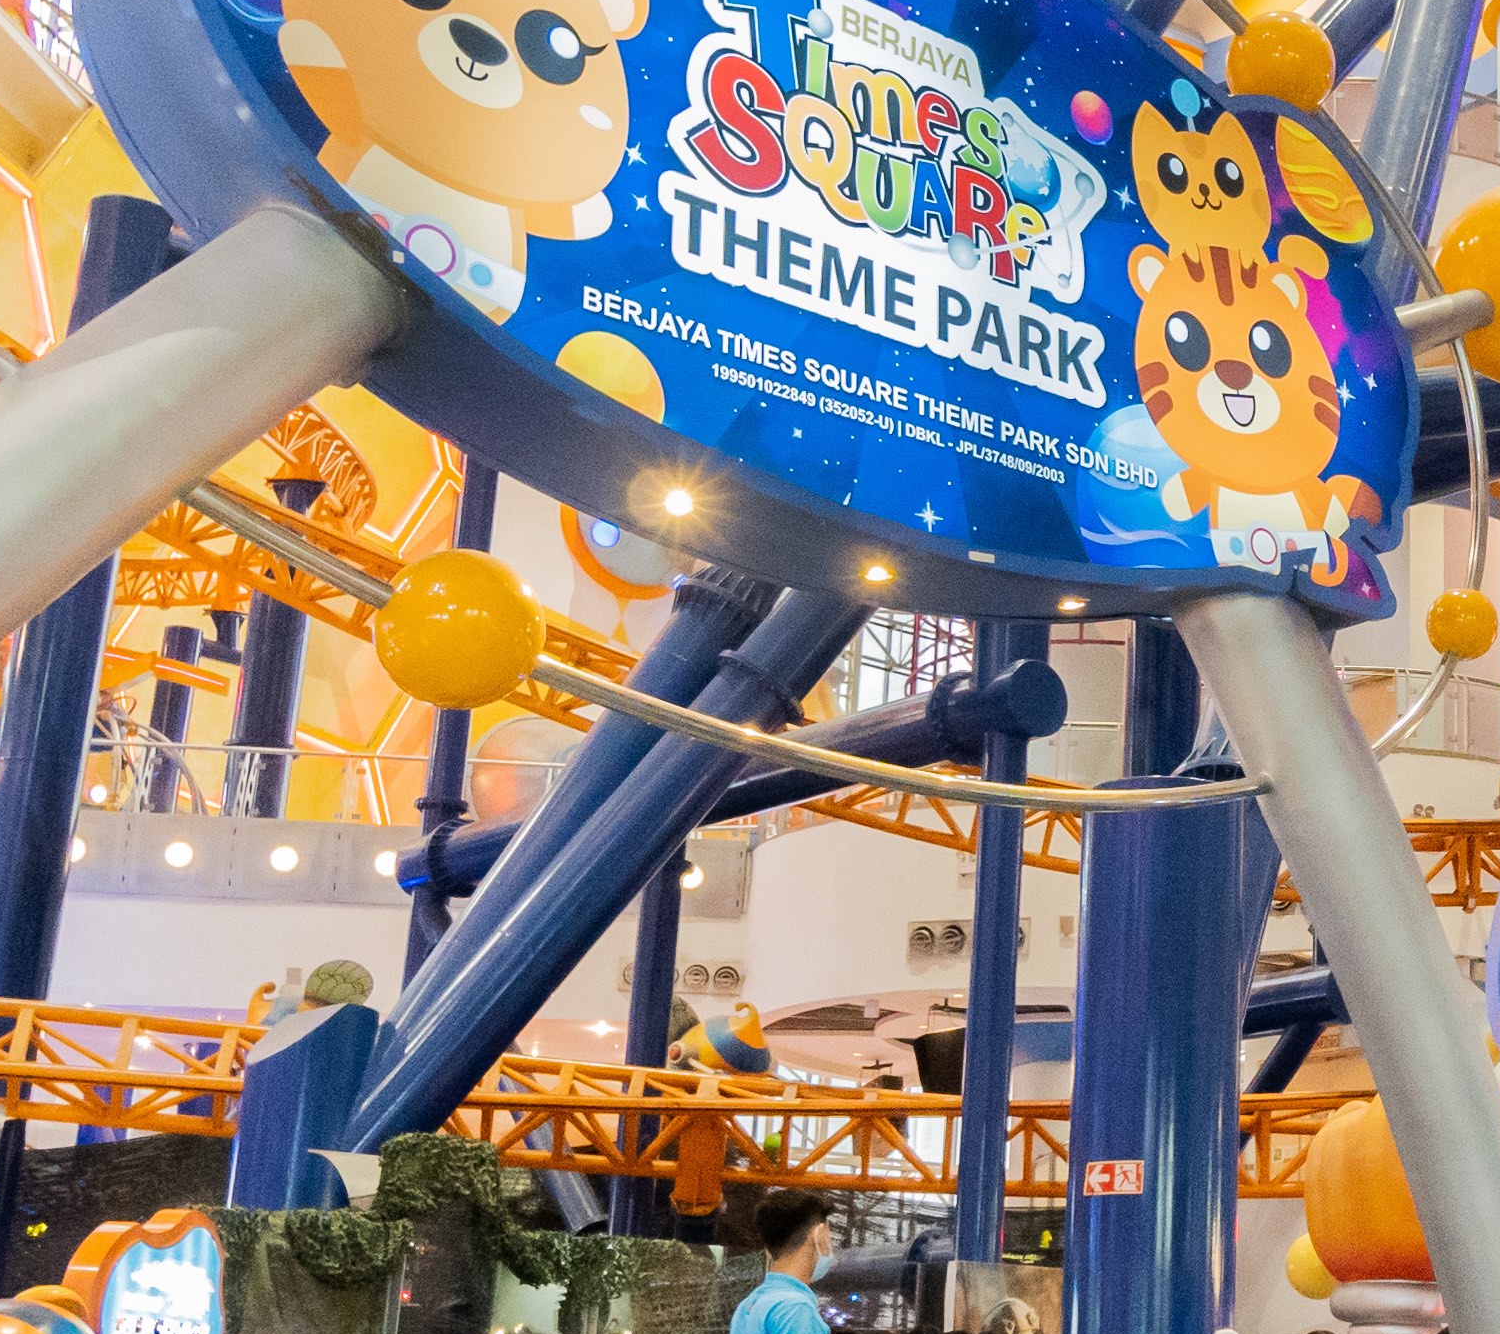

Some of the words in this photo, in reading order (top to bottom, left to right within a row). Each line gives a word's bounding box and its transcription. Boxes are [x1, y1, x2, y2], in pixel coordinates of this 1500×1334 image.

[841, 4, 973, 88] BERJAYA
[674, 189, 916, 331] THEME
[937, 285, 1093, 393] PARK
[583, 285, 712, 349] BERJAYA
[717, 328, 797, 375] TIMES
[803, 358, 909, 411] SQUARE
[914, 392, 995, 439] THEME
[1001, 420, 1061, 460] PARK
[1065, 442, 1109, 475] SDN
[1115, 458, 1159, 489] BHD
[711, 363, 817, 408] 199501022849
[819, 395, 895, 436] (352052-U)
[905, 423, 946, 448] DBKL
[956, 439, 1066, 485] JPL/3748/09/2003
